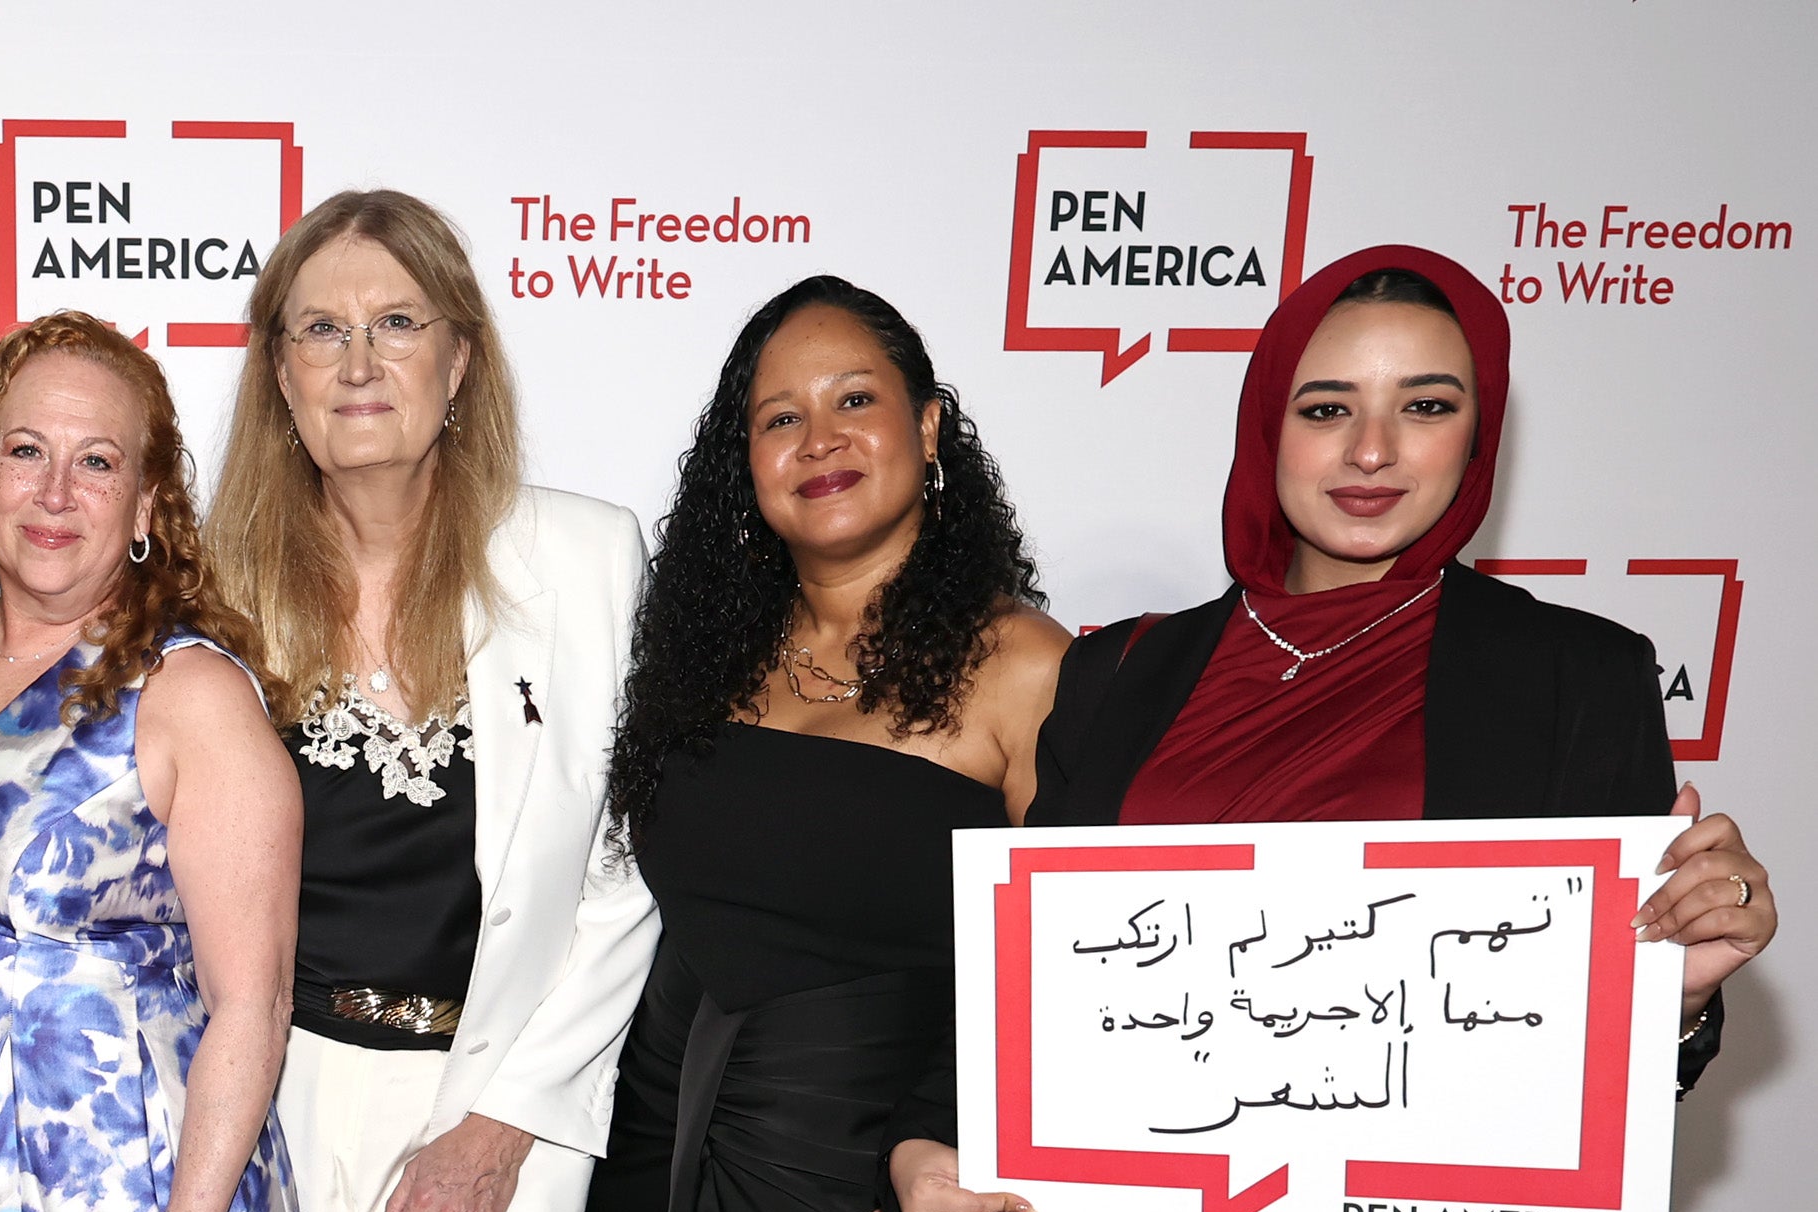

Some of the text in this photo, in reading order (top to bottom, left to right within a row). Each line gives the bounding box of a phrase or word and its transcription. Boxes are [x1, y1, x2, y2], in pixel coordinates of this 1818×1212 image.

[33, 181, 131, 224] PEN
[511, 194, 811, 243] The Freedom
[1050, 190, 1146, 232] PEN
[1508, 202, 1792, 250] The Freedom
[32, 237, 261, 280] AMERICA
[509, 255, 692, 300] to Write
[1043, 244, 1267, 287] AMERICA
[1499, 261, 1674, 305] to Write
[1228, 909, 1267, 979] لم
[1101, 992, 1214, 1041] واحدة
[1443, 982, 1543, 1032] منها
